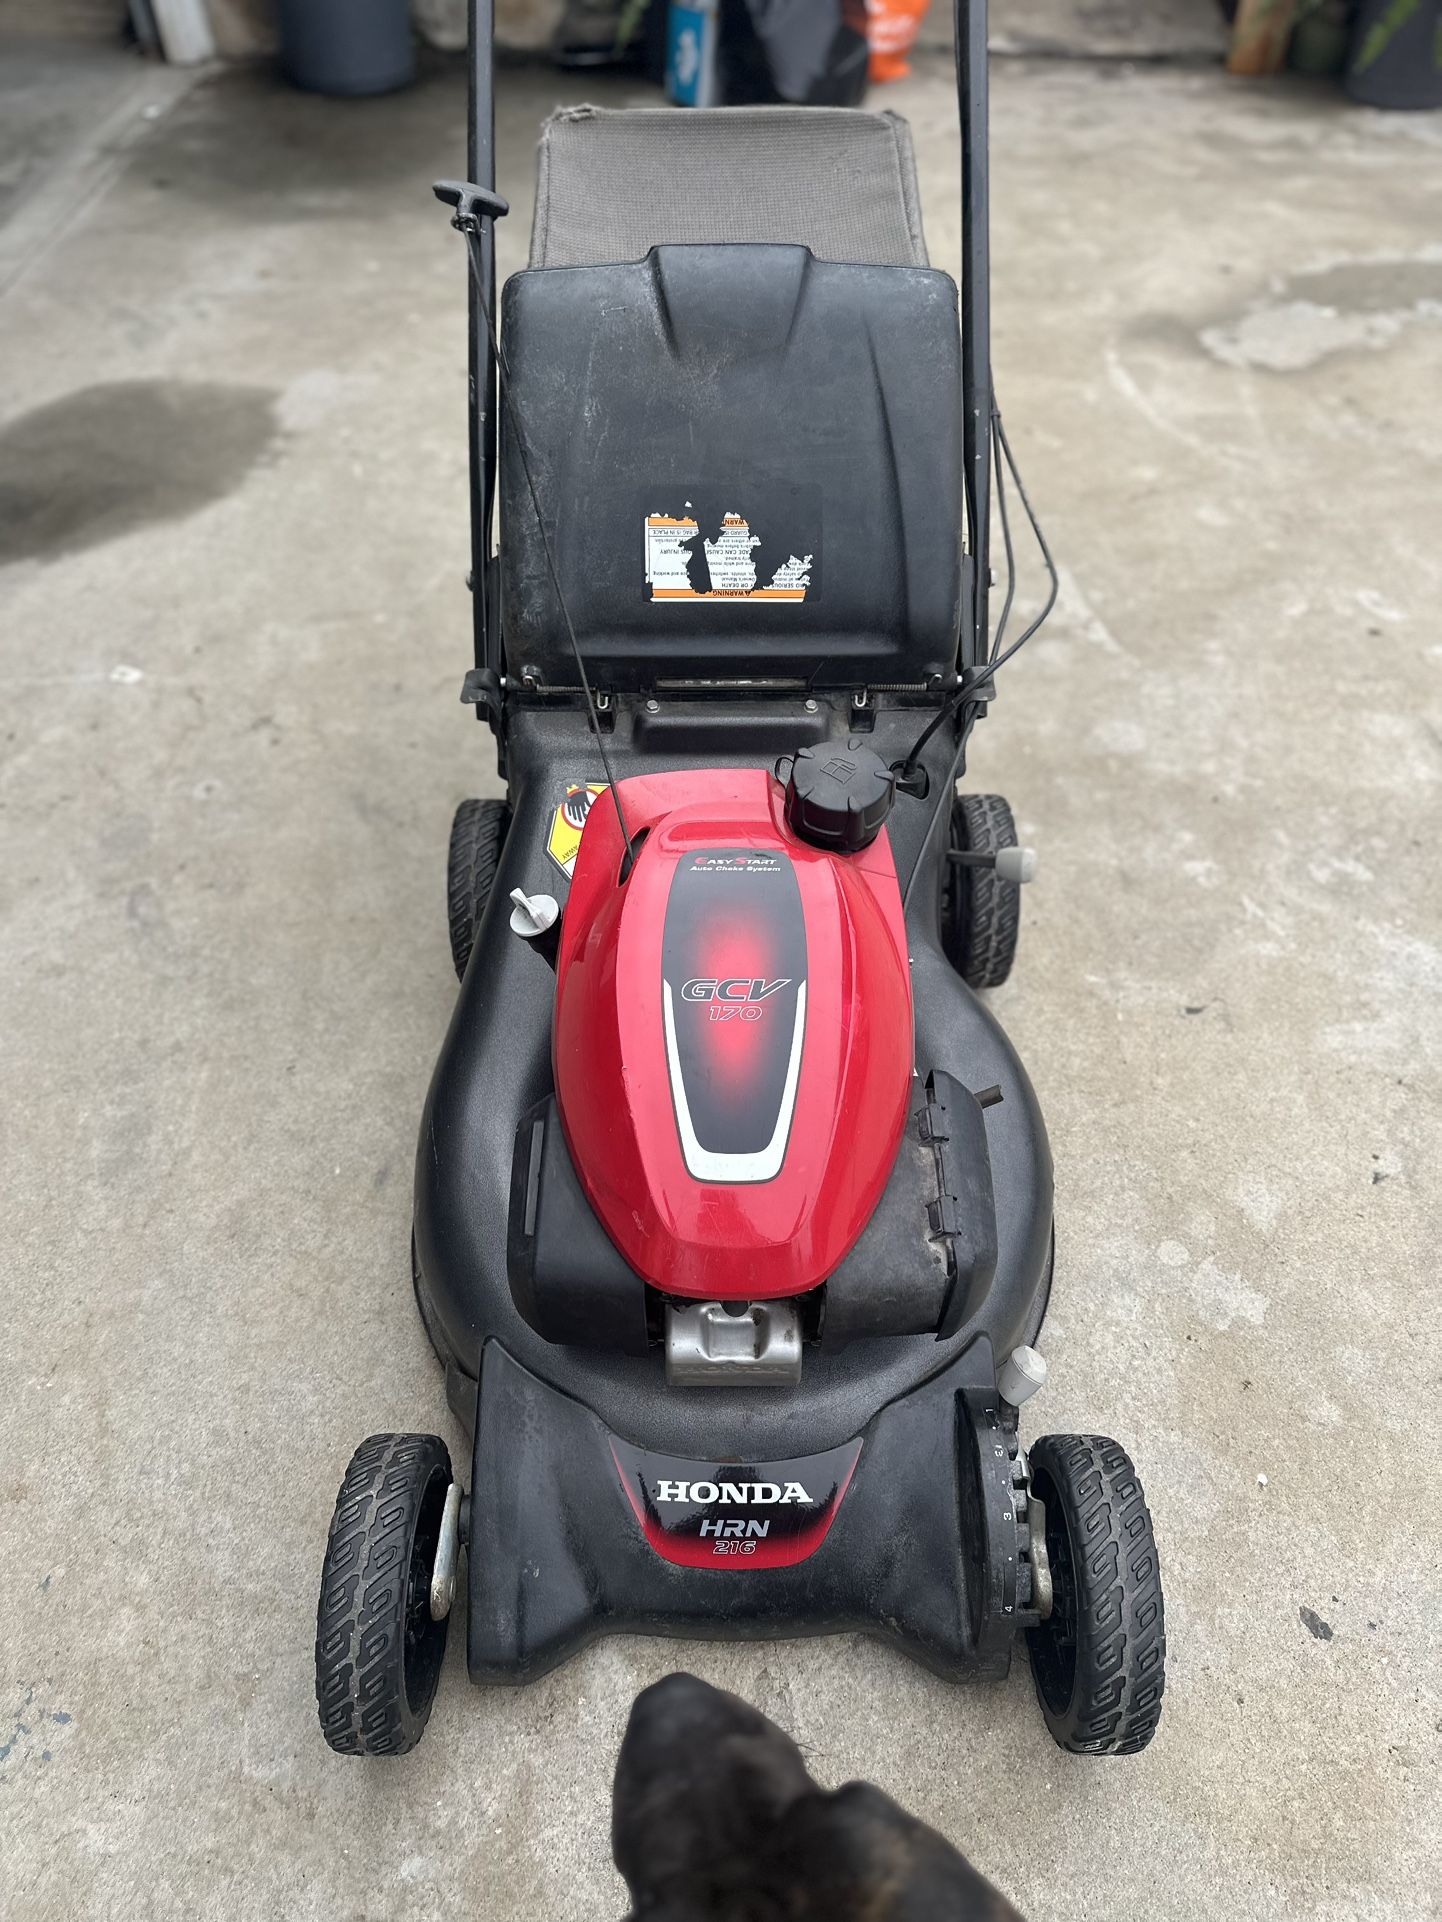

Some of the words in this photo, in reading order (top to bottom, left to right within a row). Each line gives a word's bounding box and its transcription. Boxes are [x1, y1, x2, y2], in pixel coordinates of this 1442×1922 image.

[746, 865, 781, 873] System
[681, 978, 793, 1002] GCV
[709, 1005, 763, 1021] 170
[656, 1480, 814, 1504] HONDA
[1003, 1512, 1012, 1521] 3
[699, 1519, 770, 1538] HRN
[712, 1540, 757, 1555] 216
[1004, 1605, 1014, 1613] 4
